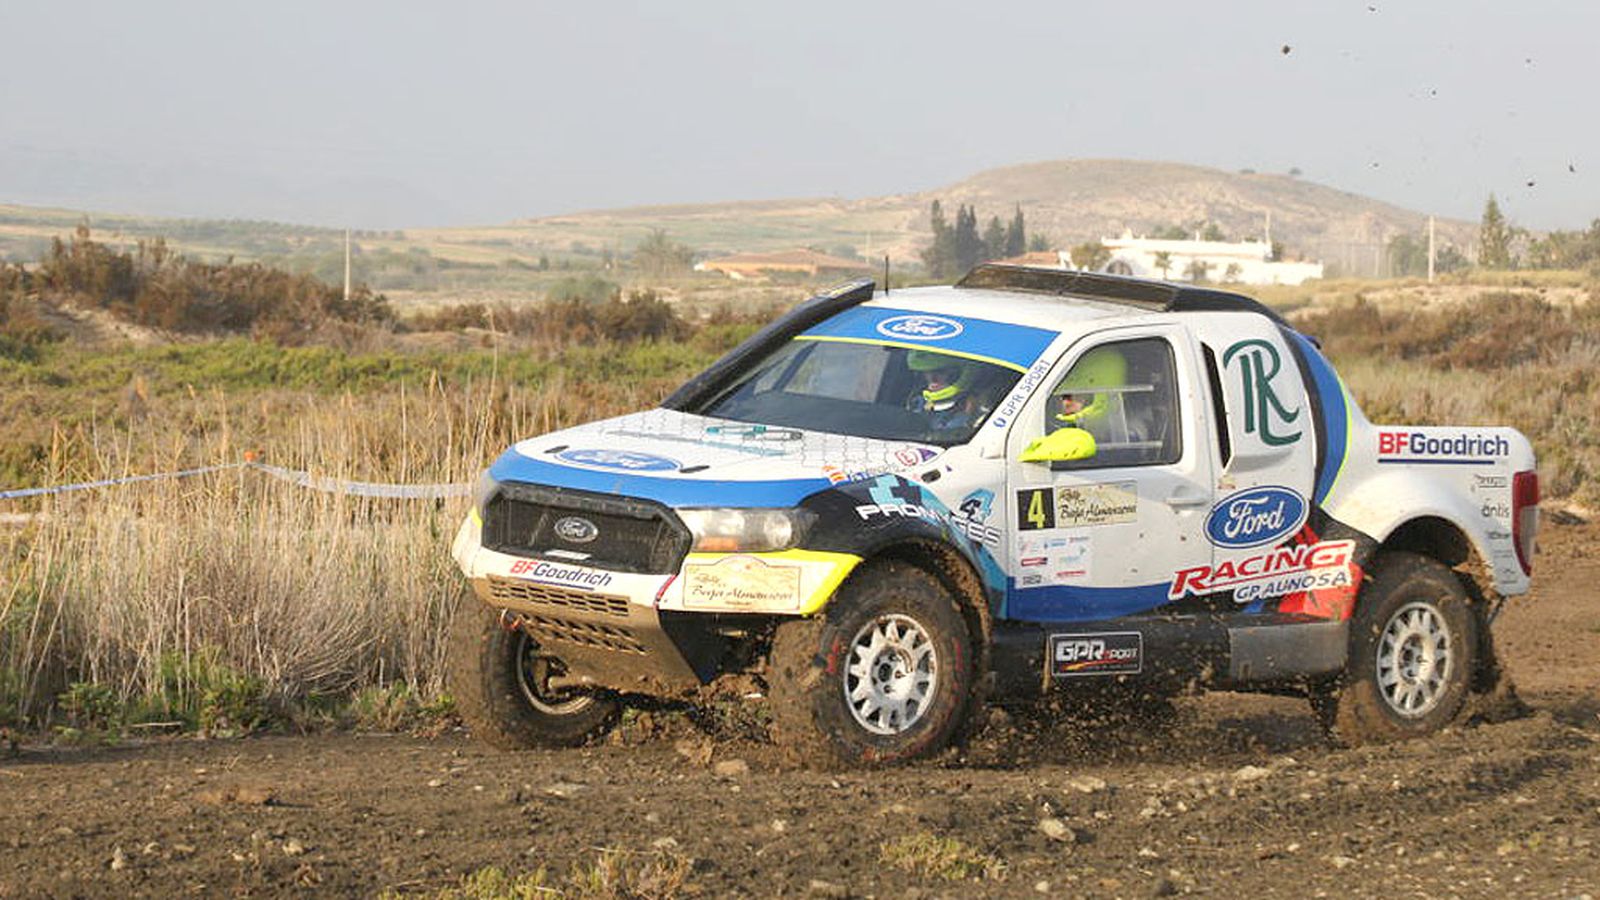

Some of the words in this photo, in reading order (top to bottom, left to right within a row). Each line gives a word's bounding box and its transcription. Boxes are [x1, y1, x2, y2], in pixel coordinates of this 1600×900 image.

[1001, 394, 1025, 417] GPR
[1025, 359, 1051, 393] SPORT
[1378, 432, 1509, 457] BFGoodrich
[1028, 491, 1045, 528] 4
[1224, 496, 1285, 538] Ford
[510, 560, 612, 587] BFGoodrich
[1172, 543, 1350, 595] RACING
[1056, 640, 1105, 661] GPR
